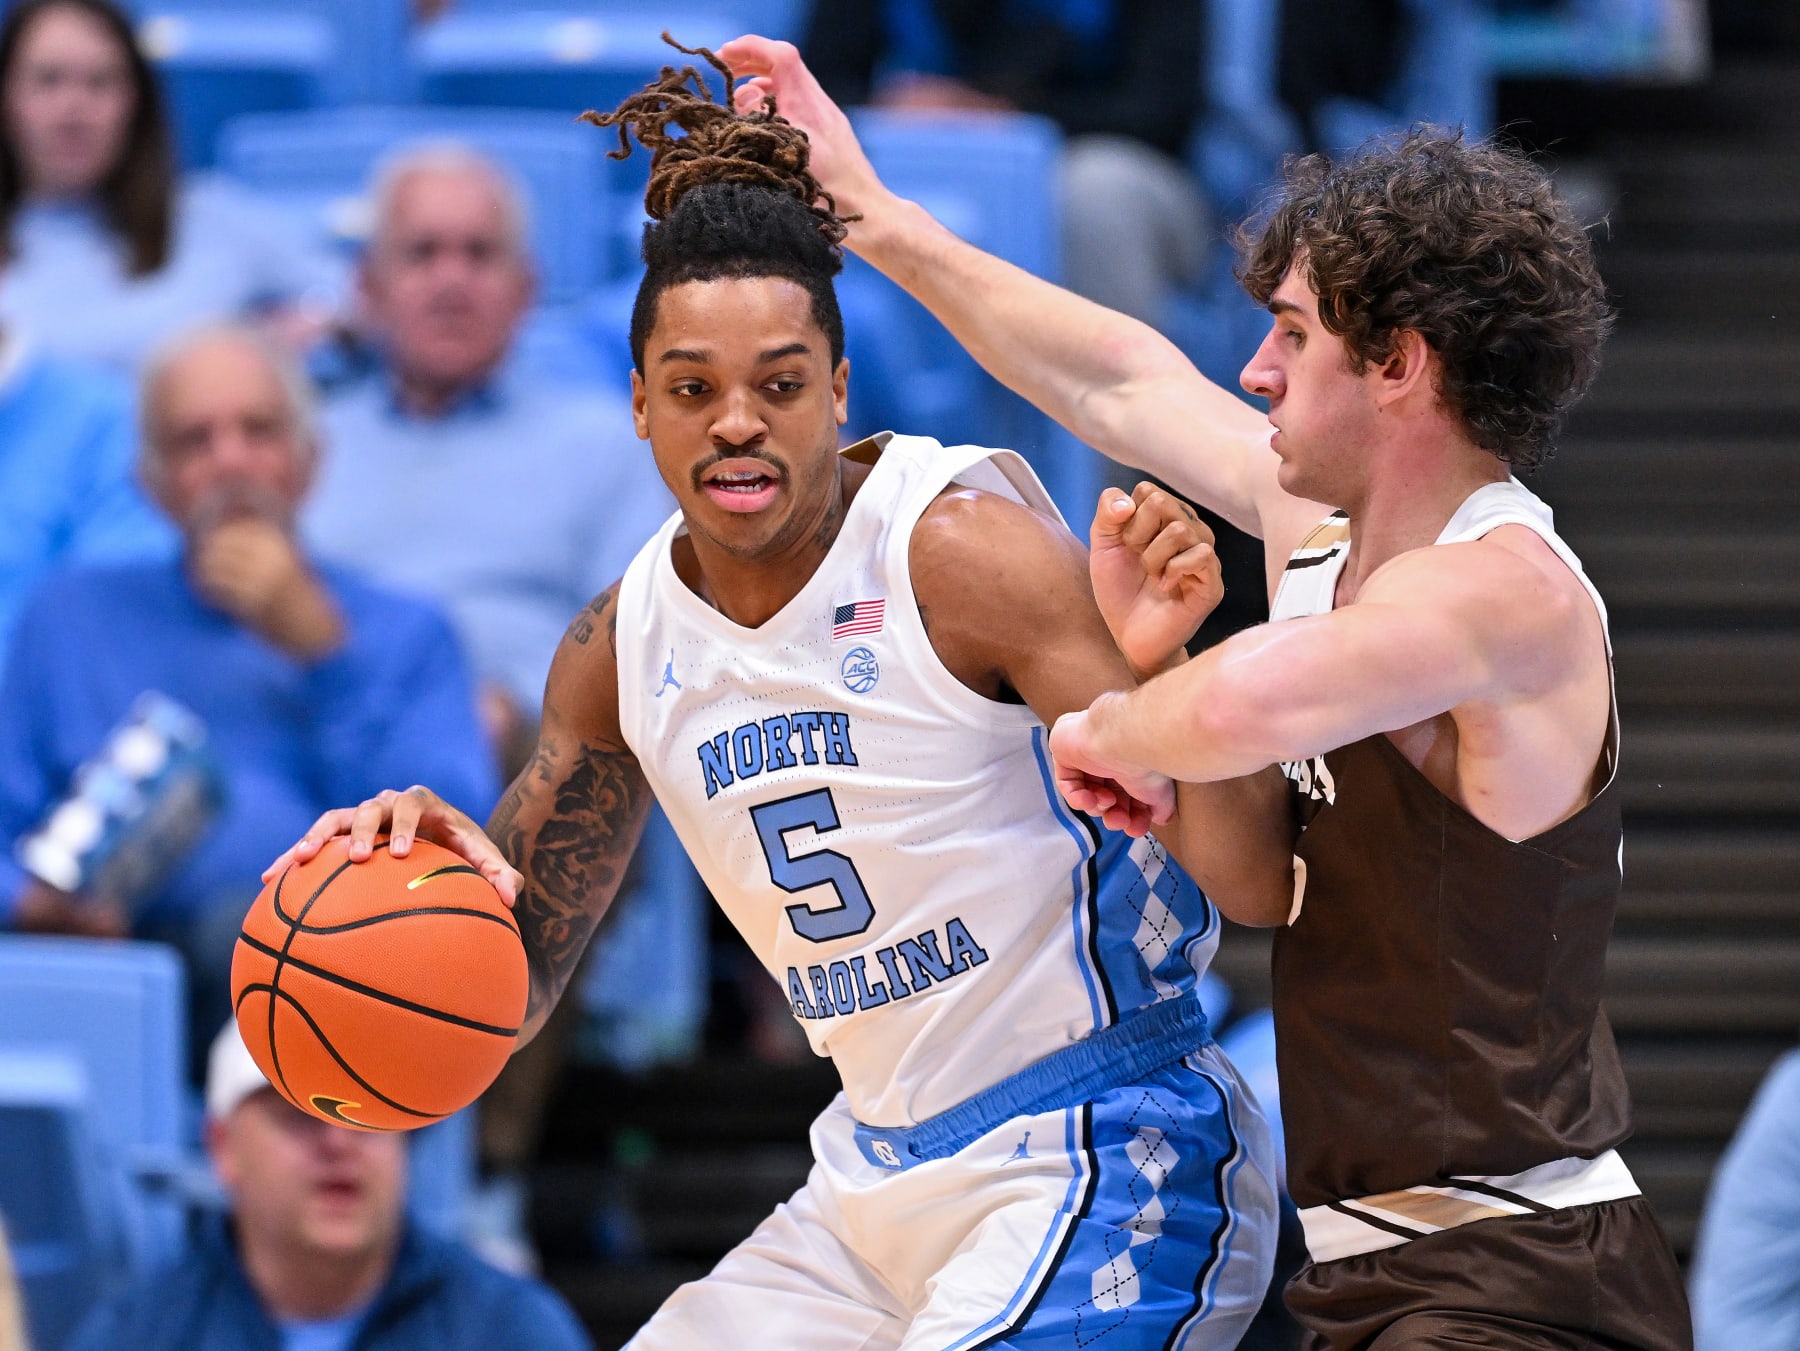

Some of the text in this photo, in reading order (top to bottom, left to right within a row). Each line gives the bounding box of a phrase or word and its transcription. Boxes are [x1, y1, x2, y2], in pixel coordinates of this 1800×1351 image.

[847, 660, 876, 674] ACC
[697, 711, 859, 799] NORTH
[748, 787, 876, 943] 5
[787, 917, 990, 1020] AROLINA
